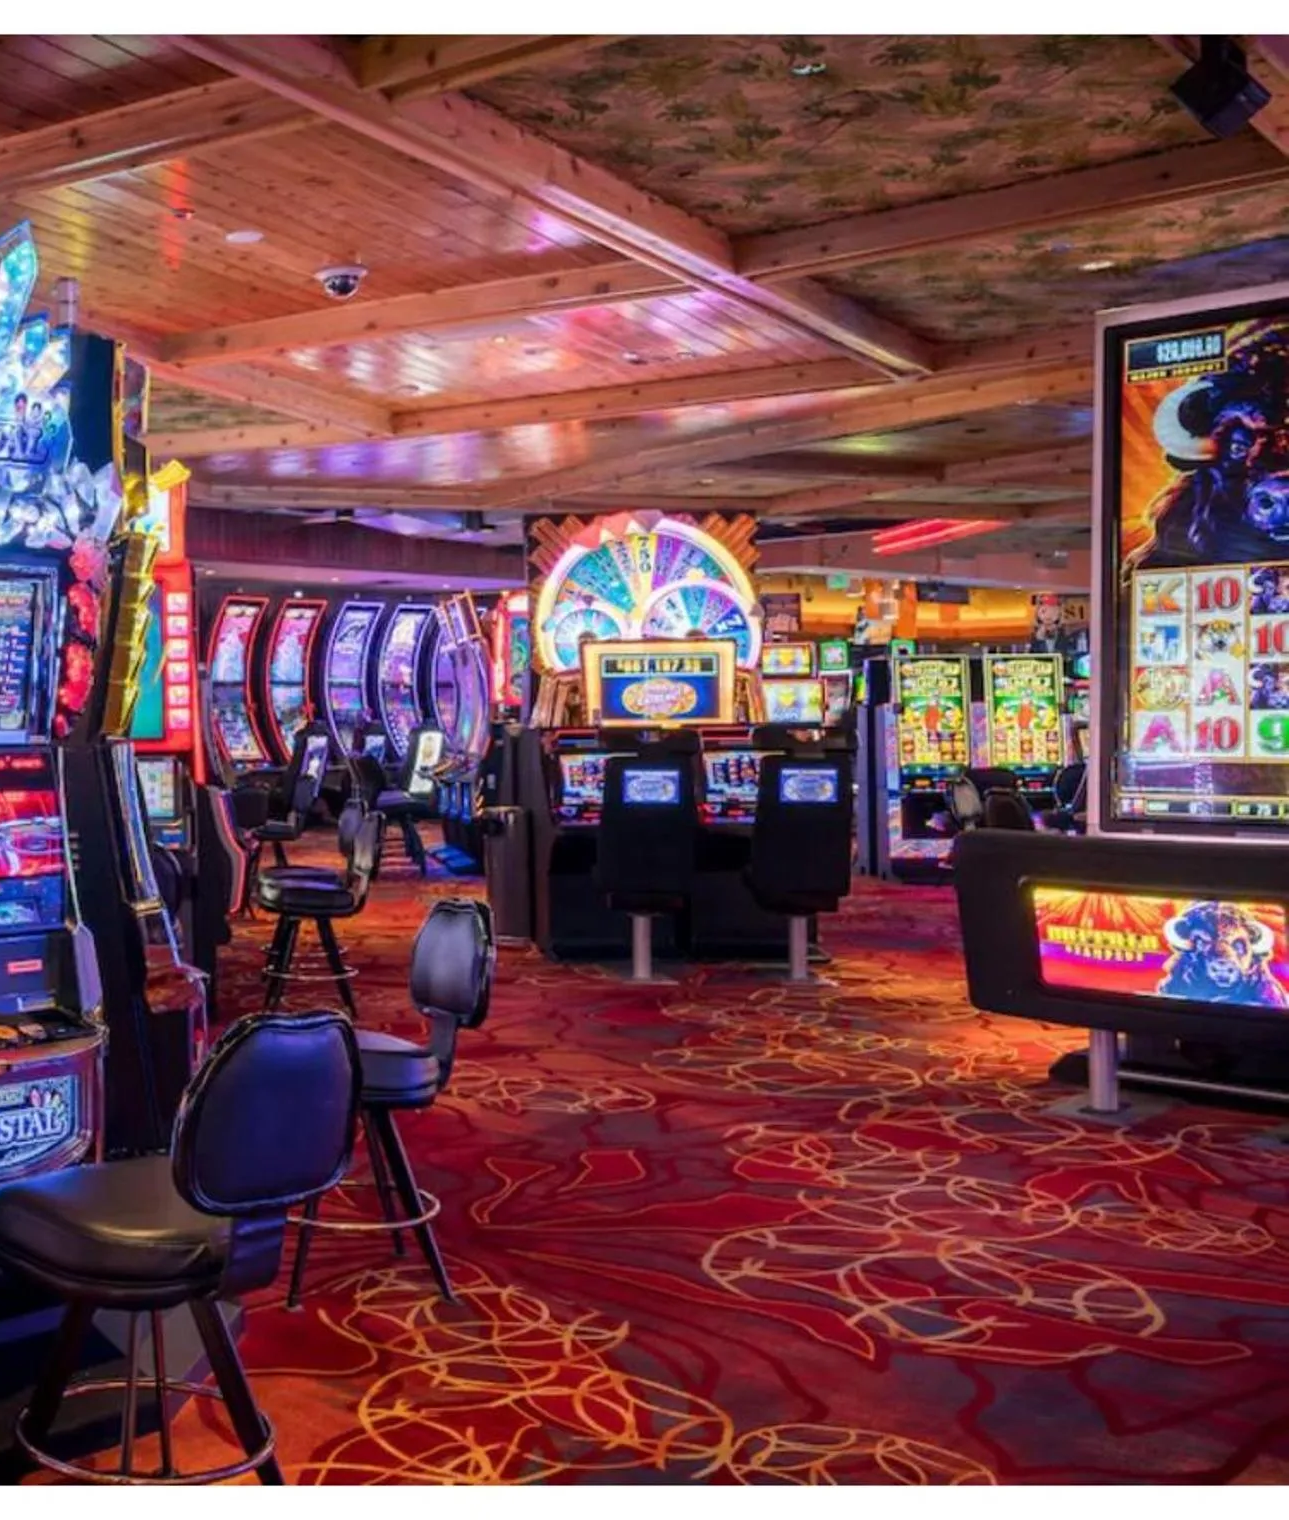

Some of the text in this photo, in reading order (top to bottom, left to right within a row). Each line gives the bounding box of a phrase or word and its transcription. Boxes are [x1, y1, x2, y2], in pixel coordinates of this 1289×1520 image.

[1195, 576, 1241, 613] 10
[1195, 668, 1242, 706] A
[1139, 714, 1185, 753] A
[1194, 716, 1242, 751] 10
